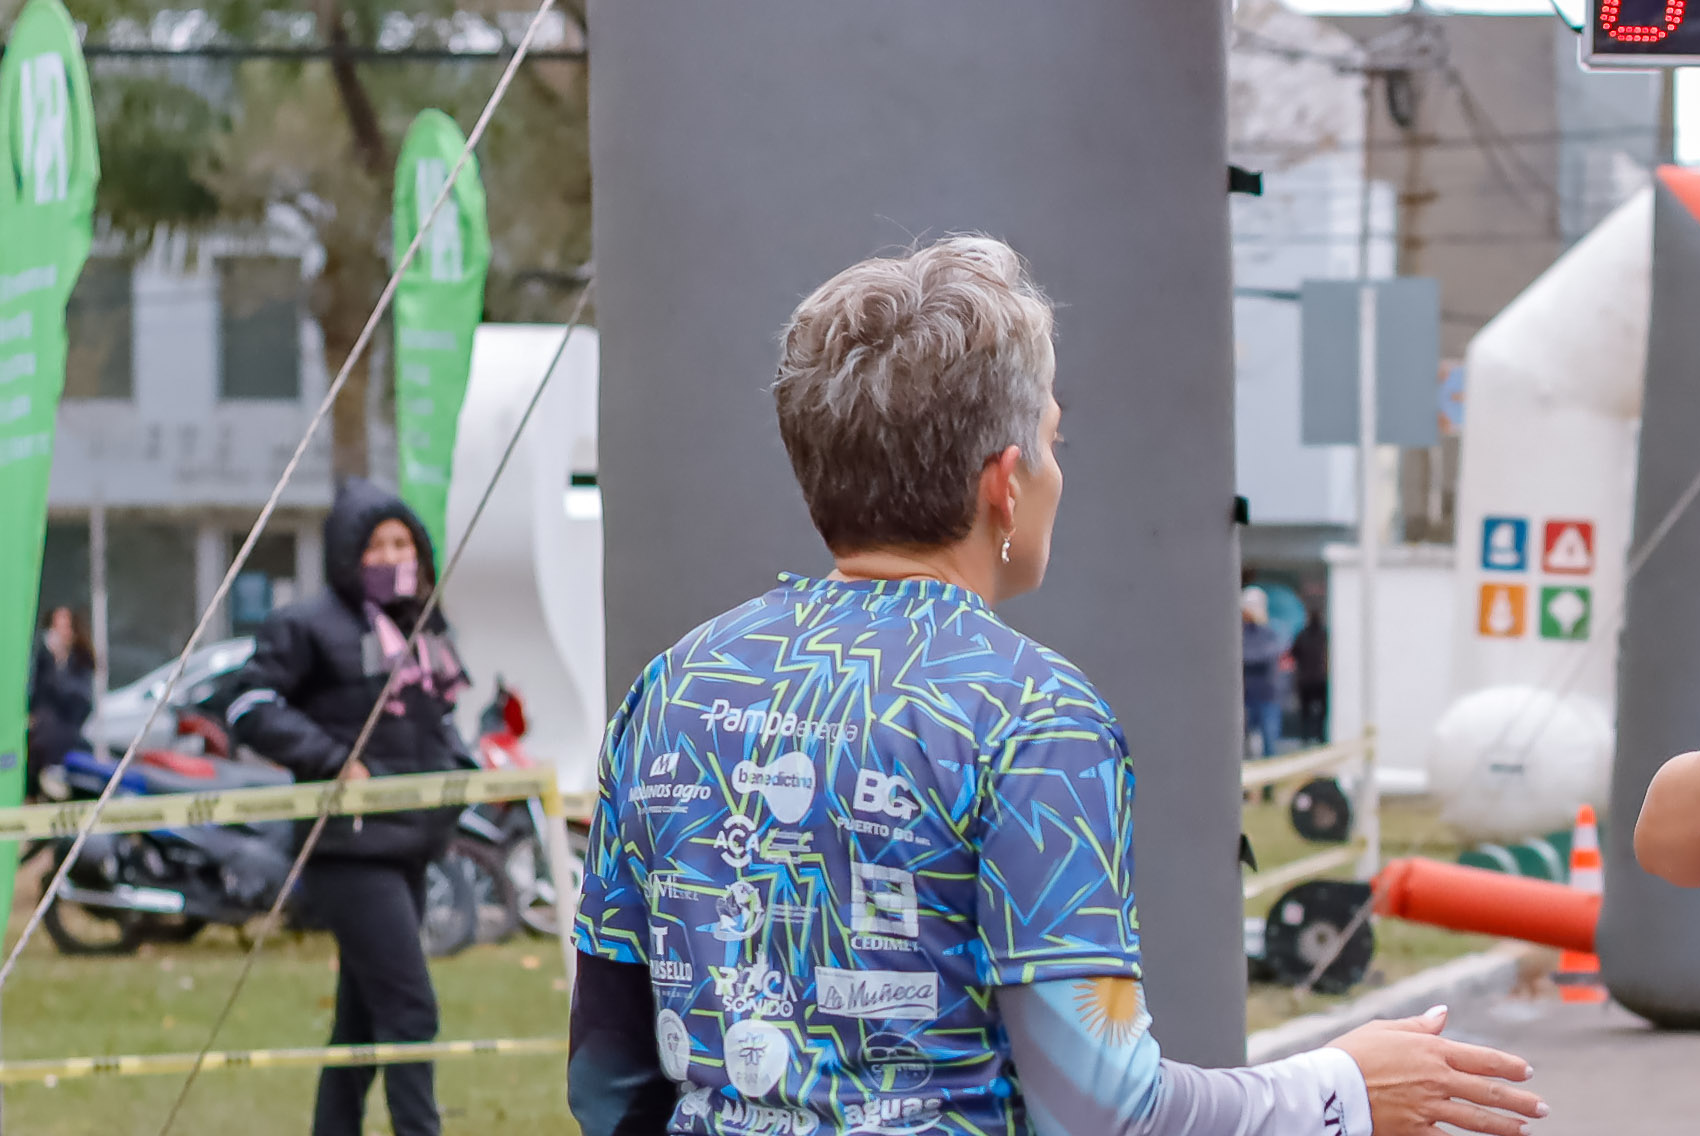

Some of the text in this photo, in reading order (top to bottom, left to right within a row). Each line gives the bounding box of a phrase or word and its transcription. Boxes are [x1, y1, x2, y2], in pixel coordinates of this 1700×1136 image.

[700, 698, 797, 749] Pampa
[672, 784, 712, 803] agro
[853, 768, 919, 820] BG
[712, 828, 761, 857] ACA
[847, 980, 934, 1010] Muñeca
